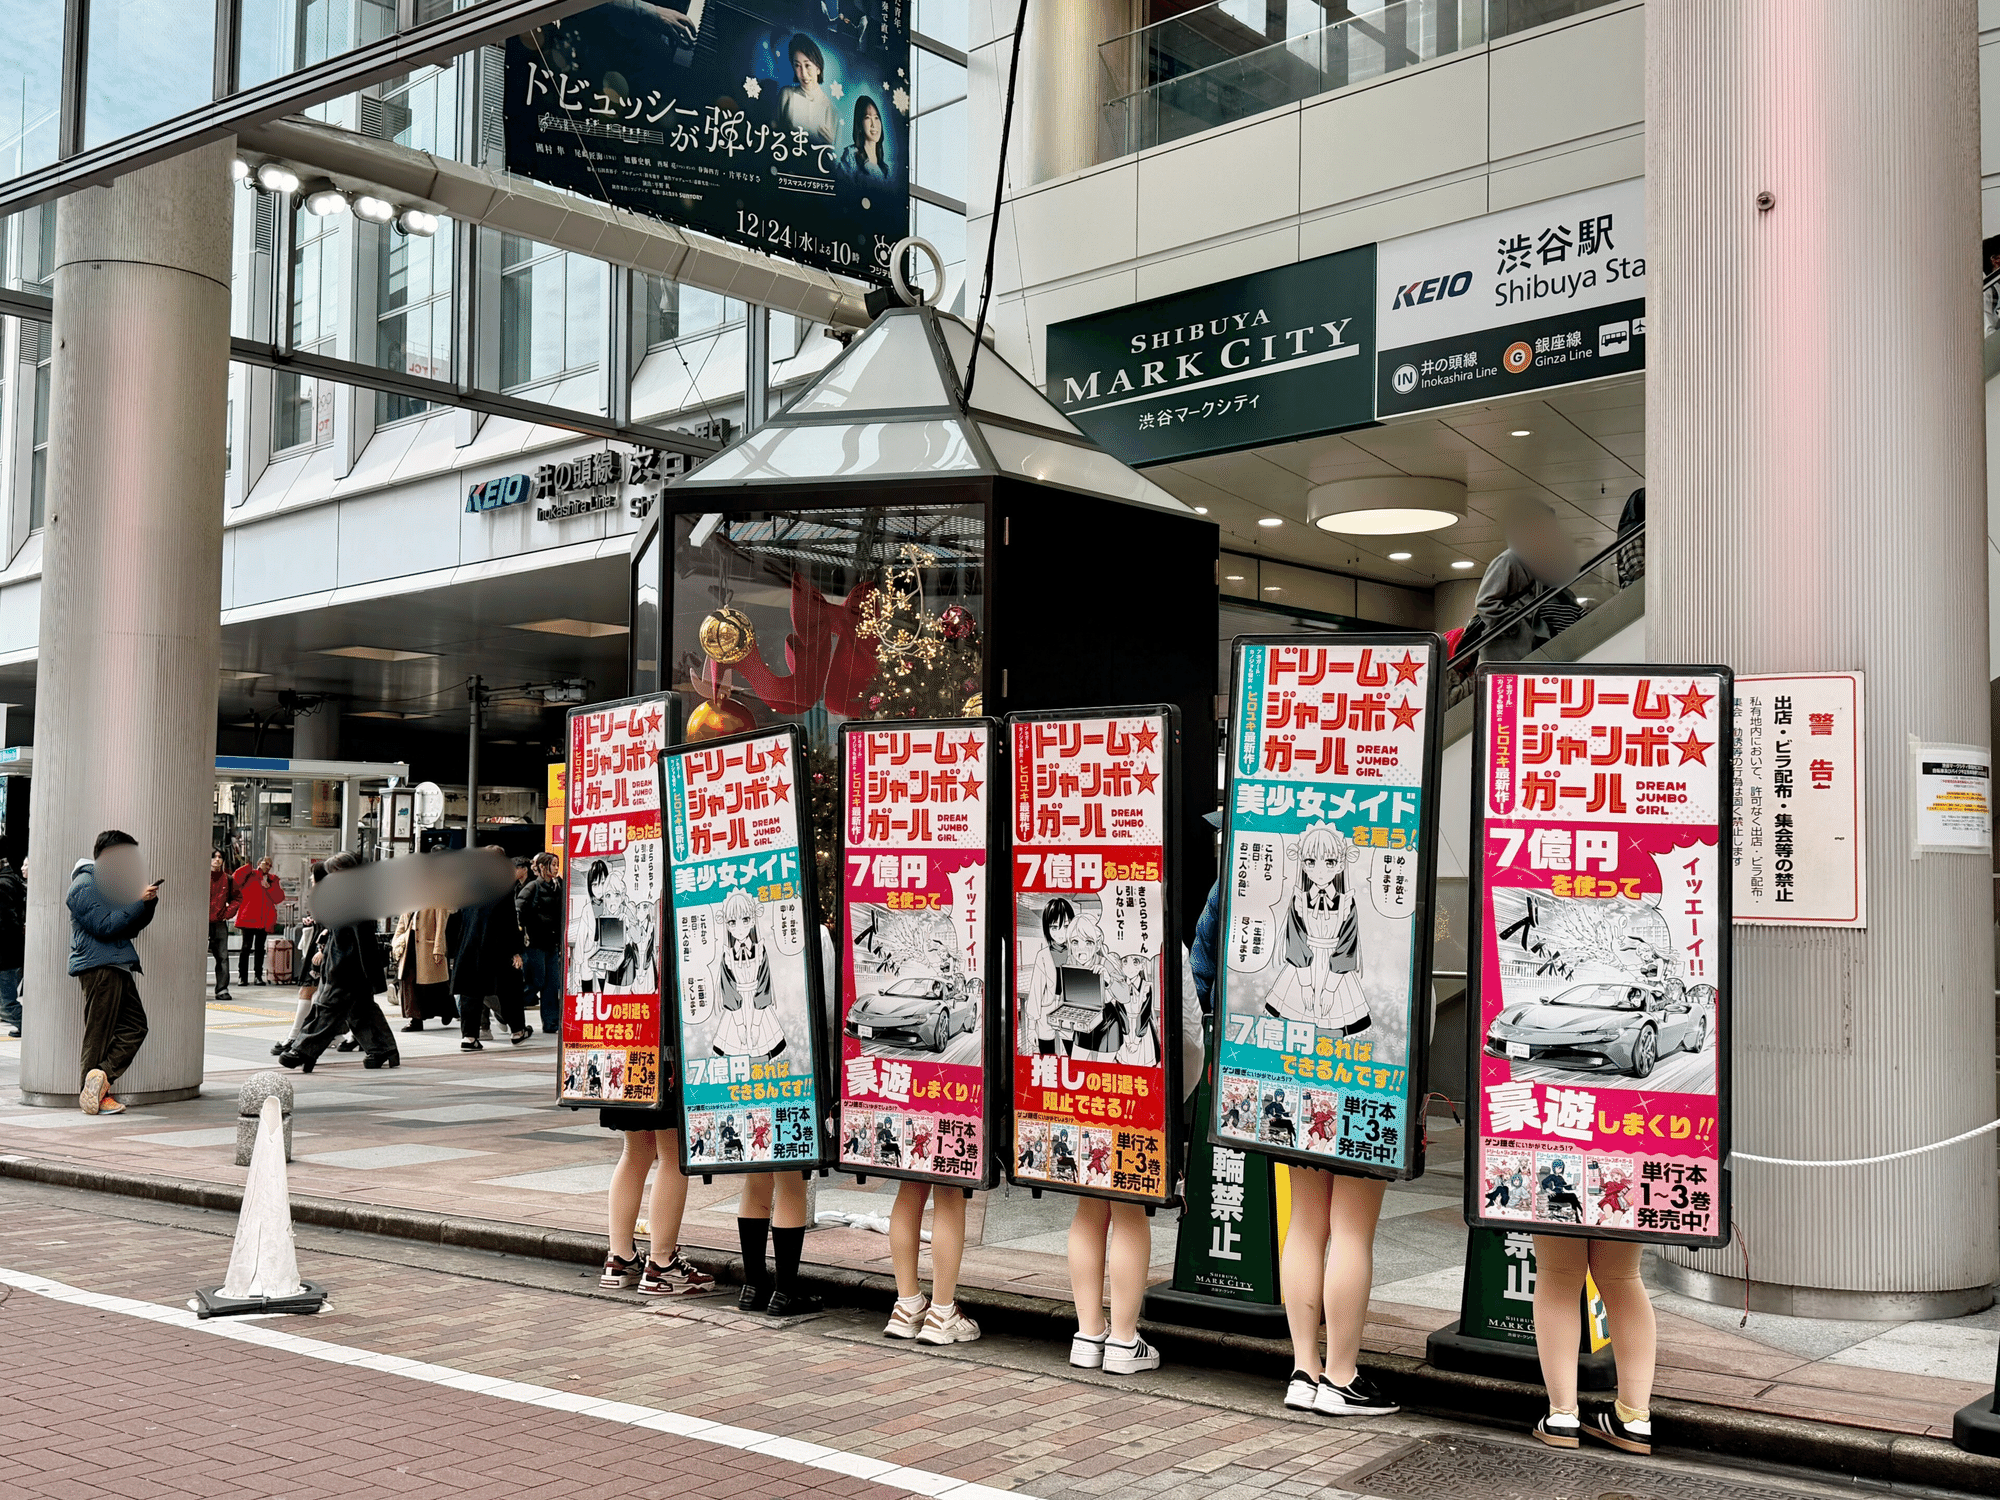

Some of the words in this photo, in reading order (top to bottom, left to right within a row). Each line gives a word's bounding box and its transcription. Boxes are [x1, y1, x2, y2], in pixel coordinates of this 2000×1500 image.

[526, 61, 699, 122] ドビュッシー
[670, 105, 838, 175] が弾けるまで
[778, 177, 835, 191] クリスマスイブSPドラマ
[1495, 214, 1616, 275] 渋谷駅
[1392, 269, 1474, 310] KEIO
[1495, 265, 1598, 308] Shibuya
[1130, 308, 1271, 354] SHIBUYA
[1534, 330, 1583, 356] 銀座線
[1062, 350, 1205, 406] MARK
[1221, 316, 1354, 370] CITY
[1421, 351, 1478, 377] 井の頭線
[1510, 350, 1523, 365] G
[1535, 351, 1562, 369] Ginza
[1566, 346, 1593, 362] Line
[1397, 371, 1413, 387] IN
[1421, 369, 1472, 391] Inokashira
[1475, 364, 1498, 380] Line
[1138, 393, 1262, 431] 渋谷マークシティ
[534, 450, 621, 499] 井の頭線
[465, 473, 531, 513] KEIO
[537, 500, 587, 521] Inokashira
[590, 494, 617, 511] Line
[1268, 647, 1388, 687] ドリーム
[1266, 691, 1391, 731] ジャンボ
[1523, 677, 1671, 720] ドリーム
[586, 709, 643, 744] ドリーム
[1035, 721, 1131, 758] ドリーム
[586, 739, 647, 777] ジャンボ
[868, 731, 958, 766] ドリーム
[1264, 734, 1349, 775] ガール
[1356, 744, 1398, 755] DREAM
[1522, 724, 1675, 767] ジャンボ
[685, 743, 767, 786] ドリーム
[1356, 756, 1399, 766] JUMBO
[1356, 767, 1383, 778] GIRL
[586, 778, 629, 810] ガール
[868, 768, 960, 803] ジャンボ
[1036, 761, 1135, 799] ジャンボ
[1521, 770, 1627, 813] ガール
[1636, 781, 1687, 791] DREAM
[687, 775, 770, 821] ジャンボ
[1236, 783, 1415, 823] 美少女メイド
[1636, 793, 1688, 803] JUMBO
[1636, 805, 1669, 815] GIRL
[1774, 695, 1794, 902] 出店・ビラ配布・集会等の禁止
[752, 817, 780, 829] DREAM
[868, 808, 932, 841] ガール
[937, 814, 968, 822] DREAM
[1037, 802, 1107, 838] ガール
[1111, 809, 1143, 817] DREAM
[1111, 820, 1144, 828] JUMBO
[571, 819, 662, 854] 7億円あったら
[690, 817, 750, 855] ガール
[753, 826, 782, 837] JUMBO
[754, 837, 773, 847] GIRL
[937, 824, 969, 832] JUMBO
[937, 833, 958, 842] GIRL
[1112, 830, 1133, 838] GIRL
[1352, 825, 1417, 852] を雇う!
[1264, 844, 1273, 881] これから
[1489, 827, 1619, 873] 7億円
[675, 851, 797, 895] 美少女メイド
[848, 854, 928, 889] 7億円
[1016, 853, 1159, 889] 7億円あったら
[886, 891, 941, 910] を使って
[1126, 886, 1135, 907] 引退
[1551, 874, 1642, 900] を使って
[1115, 886, 1125, 940] しないで!!
[1138, 886, 1149, 953] きららちゃん
[575, 992, 650, 1021] 推しの引退も
[1229, 1013, 1374, 1062] 7億円あれば
[629, 1051, 655, 1067] 単行本
[686, 1054, 790, 1086] 7億円あれば
[1280, 1054, 1405, 1092] できるんです!!
[727, 1077, 813, 1102] できるんです!!
[844, 1055, 981, 1103] 豪遊しまくり!!
[1031, 1054, 1149, 1097] 推しの引退も
[624, 1085, 655, 1100] 発売中!
[1042, 1091, 1136, 1120] 阻止できる!!
[775, 1106, 811, 1123] 単行本
[1344, 1097, 1397, 1121] 単行本
[1484, 1080, 1715, 1142] 豪遊しまくり!!
[938, 1119, 976, 1138] 単行本
[1116, 1132, 1158, 1153] 単行本
[773, 1143, 814, 1159] 発売中!
[1338, 1138, 1398, 1165] 発売中!
[933, 1156, 978, 1176] 発売中!
[1642, 1161, 1708, 1185] 単行本
[1112, 1171, 1161, 1194] 発売中!
[1637, 1208, 1710, 1232] 発売中!
[1195, 1274, 1224, 1286] MARK
[1227, 1279, 1253, 1289] CITY
[1209, 1272, 1238, 1281] SHIBUYA
[1488, 1318, 1524, 1330] MARK
